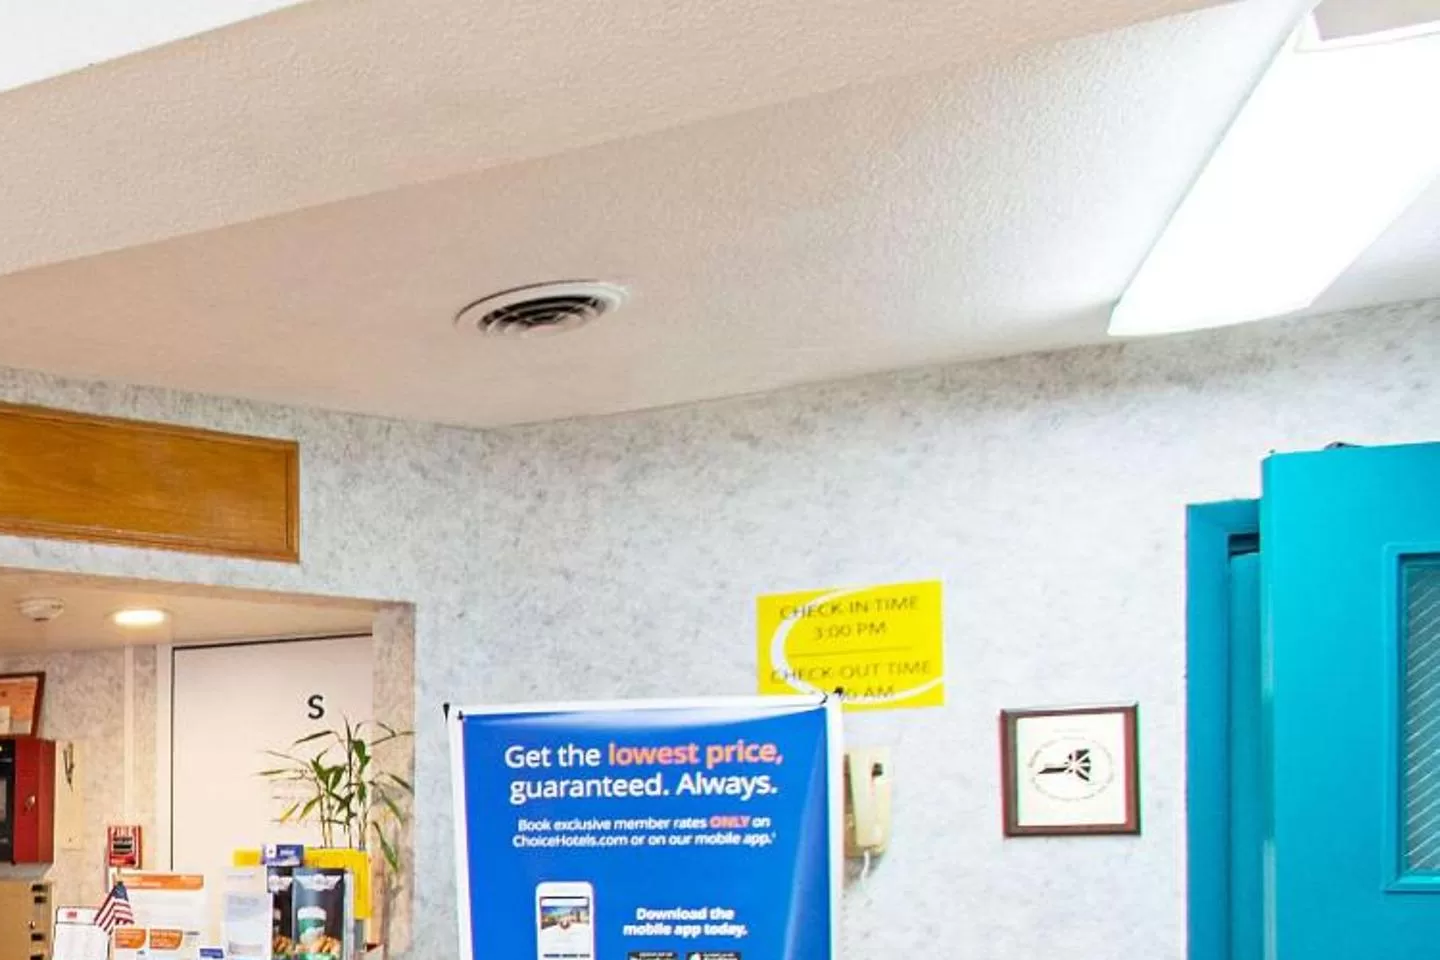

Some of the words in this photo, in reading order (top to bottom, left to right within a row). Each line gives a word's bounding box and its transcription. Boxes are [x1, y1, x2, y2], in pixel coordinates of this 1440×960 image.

[849, 601, 869, 614] IN
[874, 595, 920, 611] TIME
[857, 621, 888, 635] PM
[839, 662, 880, 679] OUT
[887, 659, 931, 675] TIME
[504, 744, 551, 769] Get
[557, 742, 602, 768] the
[607, 740, 700, 768] lowest
[705, 738, 784, 770] price,
[509, 772, 670, 805] guaranteed.
[675, 770, 778, 802] Always.
[517, 817, 551, 833] Book
[553, 816, 611, 832] exclusive
[613, 816, 671, 832] member
[673, 816, 708, 831] rates
[709, 815, 751, 829] ONLY
[751, 816, 771, 829] on
[512, 833, 629, 849] ChoiceHotels.com
[630, 835, 646, 847] or
[648, 834, 666, 847] on
[671, 834, 693, 846] our
[694, 830, 741, 846] mobile
[635, 906, 708, 921] Download
[709, 906, 735, 921] the
[623, 922, 672, 937] mobile
[673, 923, 702, 939] app
[703, 922, 748, 939] today.
